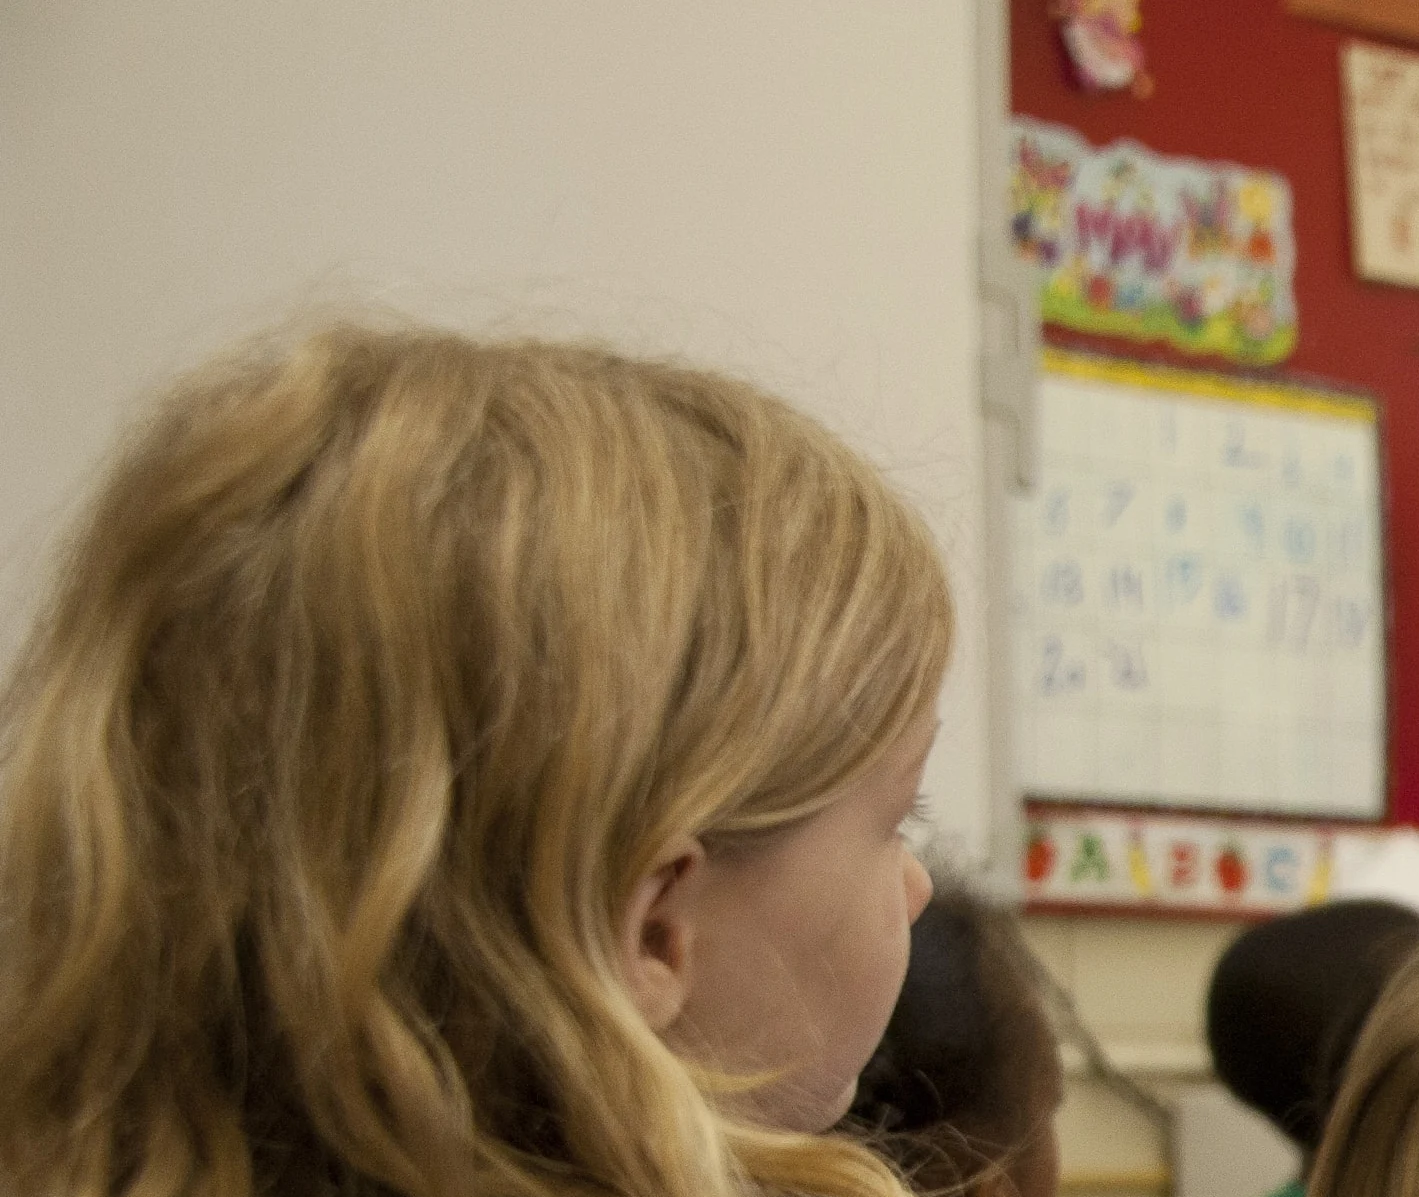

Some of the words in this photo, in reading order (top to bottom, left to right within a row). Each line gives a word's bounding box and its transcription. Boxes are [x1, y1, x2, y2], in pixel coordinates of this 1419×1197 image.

[1266, 574, 1322, 652] 17
[1070, 835, 1110, 884] A
[1169, 840, 1199, 888] B
[1263, 845, 1299, 892] C
